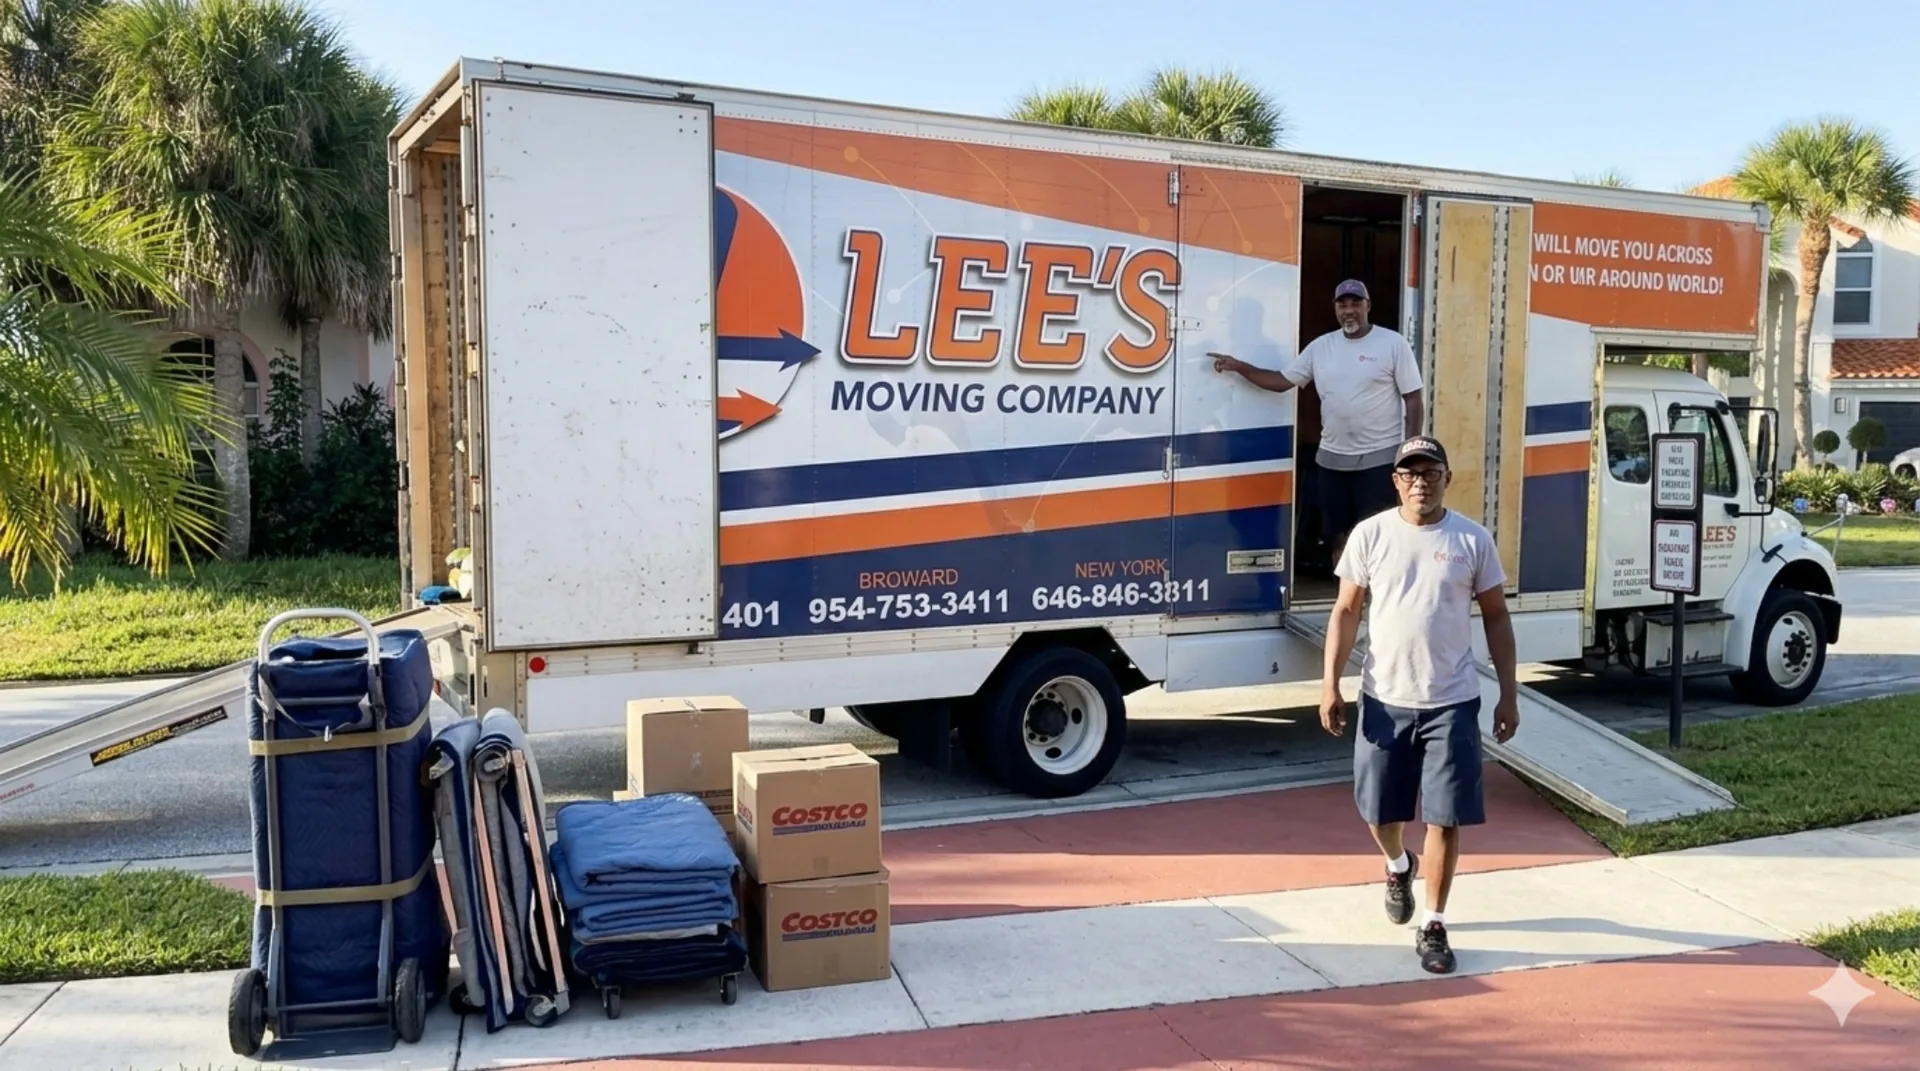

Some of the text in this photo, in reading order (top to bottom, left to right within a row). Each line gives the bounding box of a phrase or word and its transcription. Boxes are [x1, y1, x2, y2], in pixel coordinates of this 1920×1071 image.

[1534, 232, 1713, 265] WILL MOVE YOU ACROSS
[1542, 264, 1565, 284] OR
[1599, 268, 1664, 291] AROUND
[1666, 273, 1724, 295] WORLD!
[840, 226, 1183, 374] LEE'S
[831, 381, 1165, 415] MOVING COMPANY
[859, 569, 960, 590] BROWARD
[1075, 558, 1169, 578] NEW YORK
[808, 588, 1009, 624] 954-753-3411
[1032, 578, 1209, 611] 646-846-3811
[722, 600, 780, 629] 401
[772, 802, 868, 826] COSTCO
[781, 908, 878, 933] COSTCO
